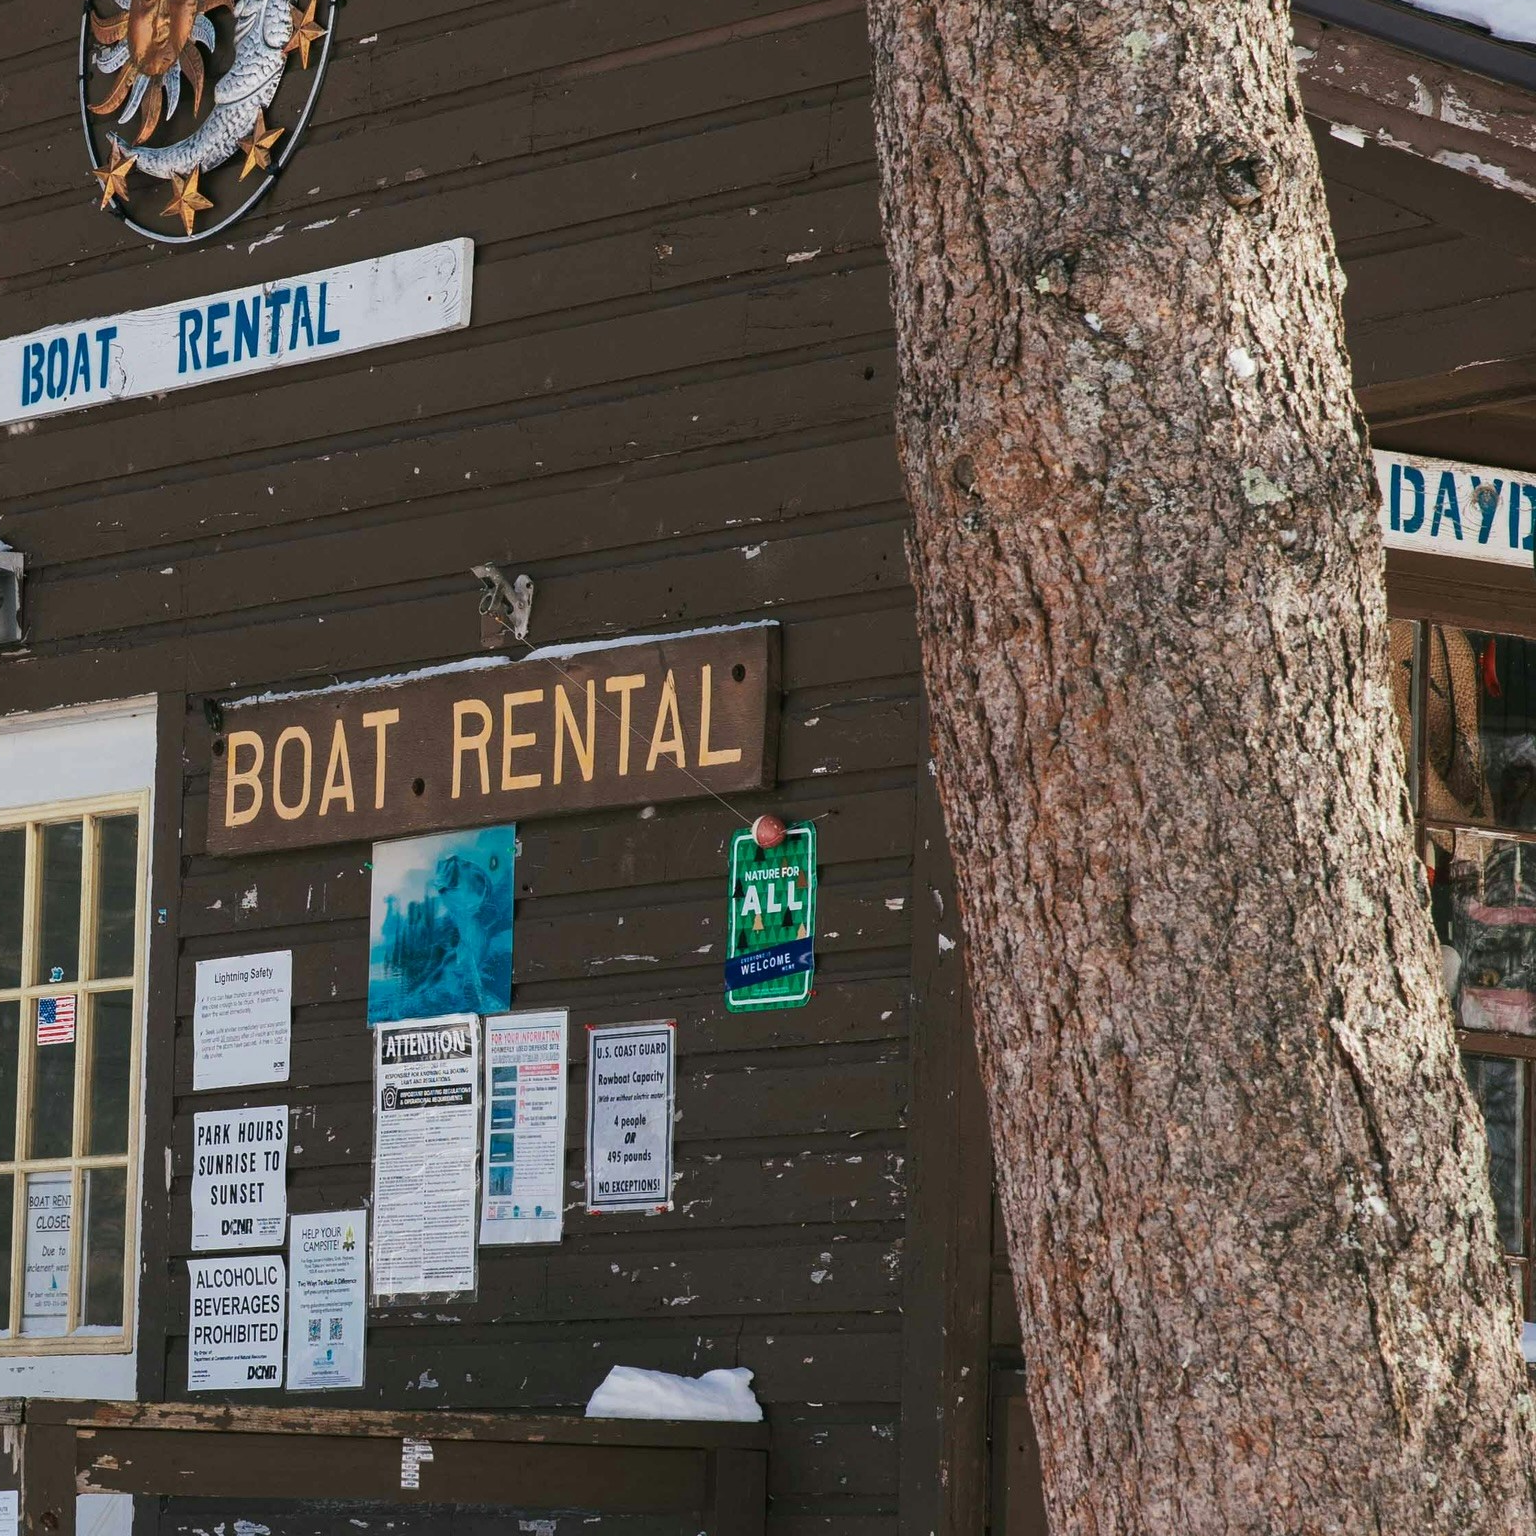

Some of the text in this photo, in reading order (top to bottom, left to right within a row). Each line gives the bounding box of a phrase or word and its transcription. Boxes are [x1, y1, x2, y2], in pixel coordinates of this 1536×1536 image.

[21, 326, 118, 407] BOAT
[178, 281, 341, 374] RENTAL
[224, 663, 742, 827] BOAT RENTAL
[744, 865, 800, 882] NATURE FOR
[740, 880, 803, 917] ALL
[740, 952, 791, 976] WELCOME
[214, 967, 274, 986] Lightning Safety
[385, 1029, 467, 1058] ATTENTION
[491, 1033, 502, 1044] FOR
[597, 1042, 667, 1060] U.S. COAST GUARD
[598, 1070, 665, 1086] Rowboat Capacity
[614, 1113, 647, 1130] 4 people
[197, 1119, 284, 1146] PARK HOURS
[624, 1131, 636, 1145] OR
[198, 1150, 280, 1176] SUNRISE TO
[607, 1150, 652, 1165] 495 pounds
[210, 1182, 265, 1205] SUNSET
[598, 1178, 660, 1194] NO EXCEPTIONS!
[29, 1194, 72, 1207] BOAT RENT
[221, 1218, 254, 1236] DCNR
[301, 1226, 342, 1240] HELP YOUR
[41, 1244, 66, 1257] Due to
[303, 1239, 340, 1252] CAMPSITE!
[196, 1266, 278, 1289] ALCOHOLIC
[194, 1294, 280, 1317] BEVERAGES
[194, 1323, 279, 1345] PROHIBITED
[247, 1365, 277, 1381] DCNR
